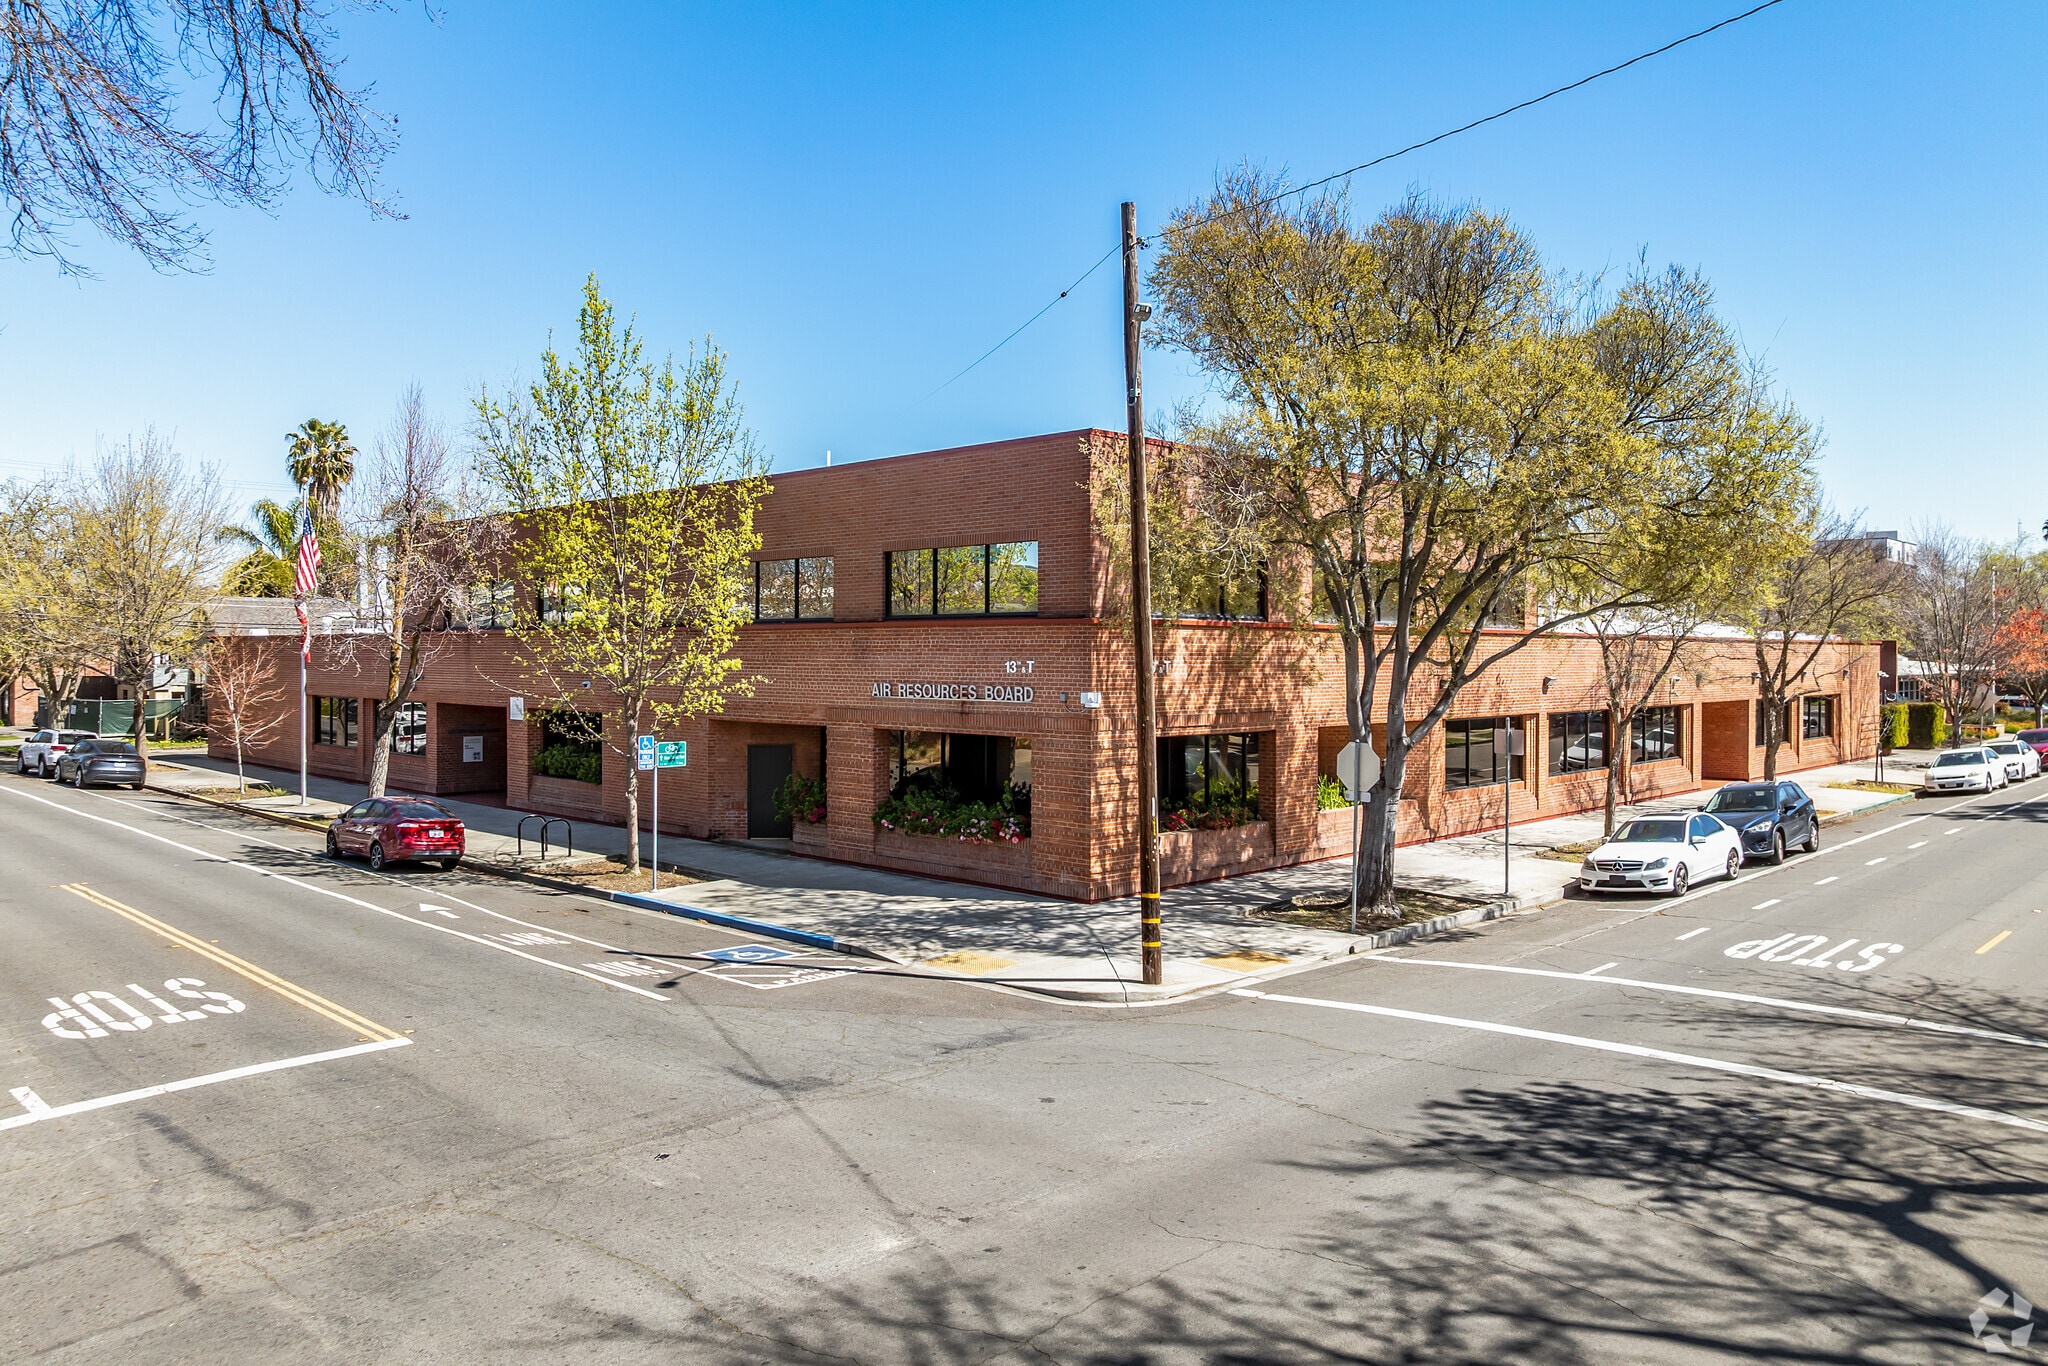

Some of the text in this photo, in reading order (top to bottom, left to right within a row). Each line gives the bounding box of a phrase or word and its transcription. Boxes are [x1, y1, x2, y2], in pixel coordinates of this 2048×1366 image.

[1026, 660, 1035, 673] T
[872, 682, 1034, 702] AIR RESOURCES BOARD
[1723, 932, 1905, 972] STOP
[41, 977, 246, 1039] STOP
